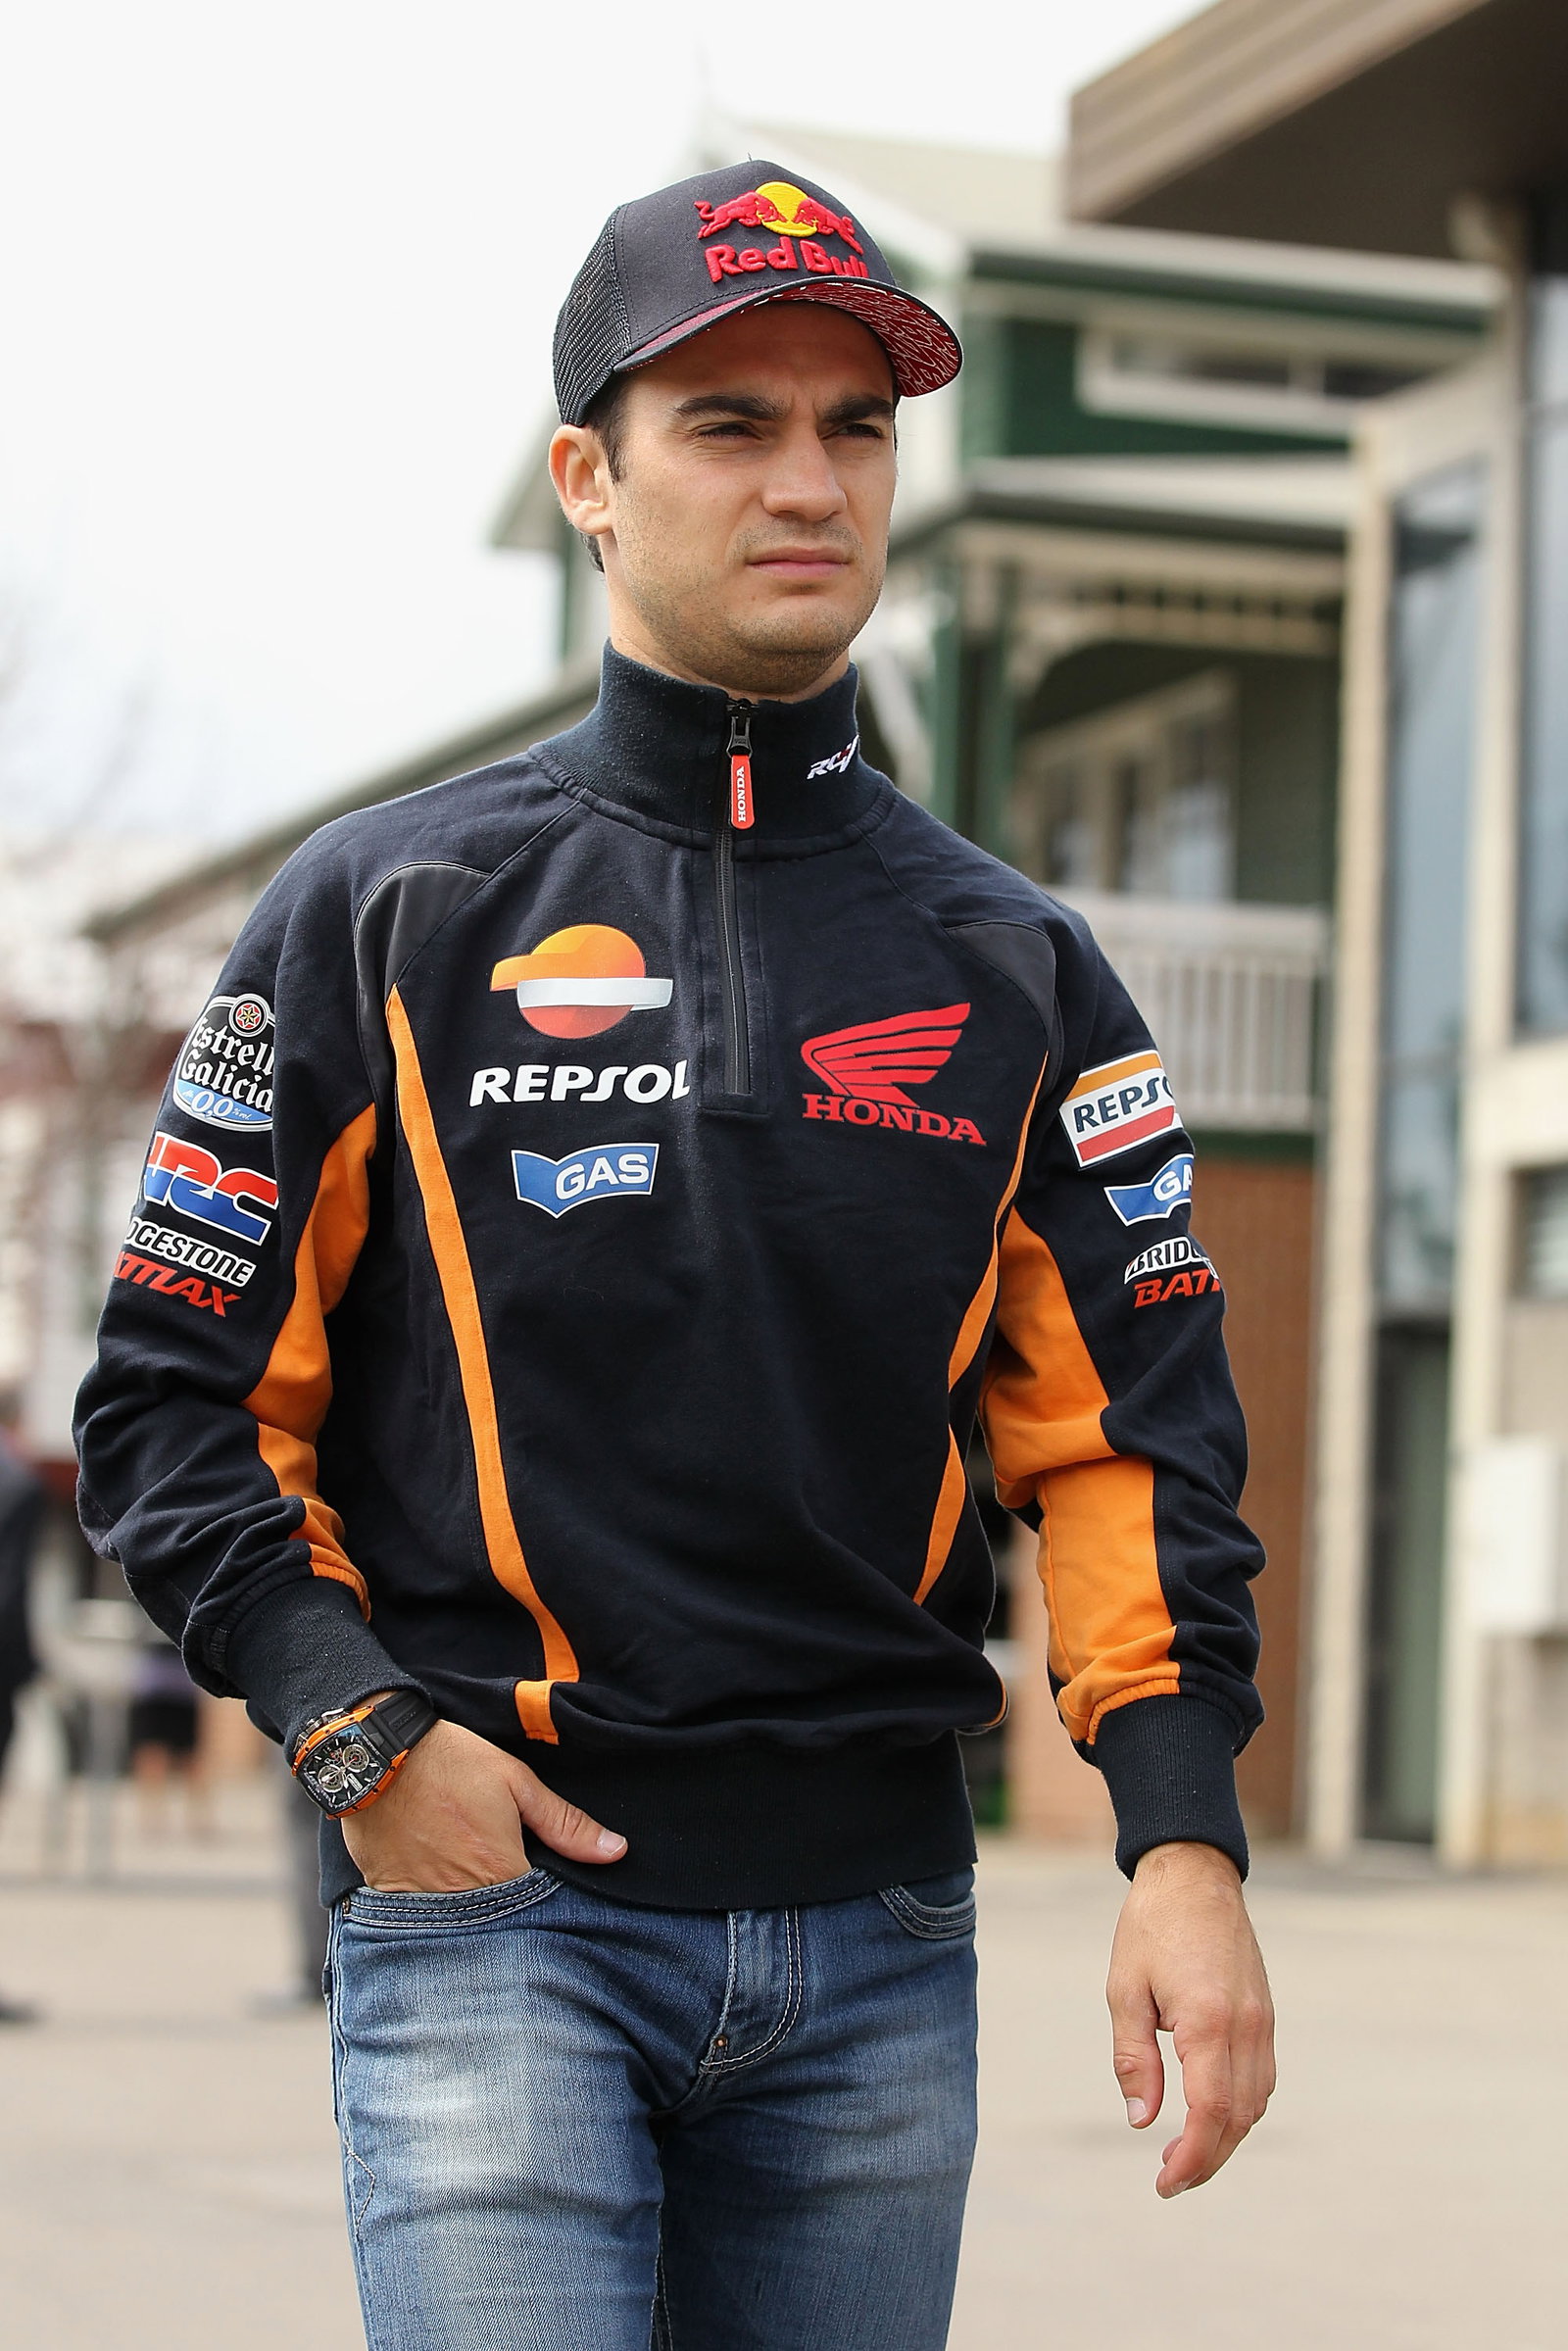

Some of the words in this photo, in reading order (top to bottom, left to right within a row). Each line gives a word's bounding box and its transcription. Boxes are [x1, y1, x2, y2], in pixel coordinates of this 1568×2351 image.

[705, 236, 799, 283] Red
[800, 240, 869, 278] Bull
[736, 765, 747, 822] HONDA
[181, 1049, 273, 1113] Galicia
[469, 1059, 690, 1107] REPSOL
[802, 1093, 987, 1147] HONDA
[556, 1153, 650, 1200] GAS
